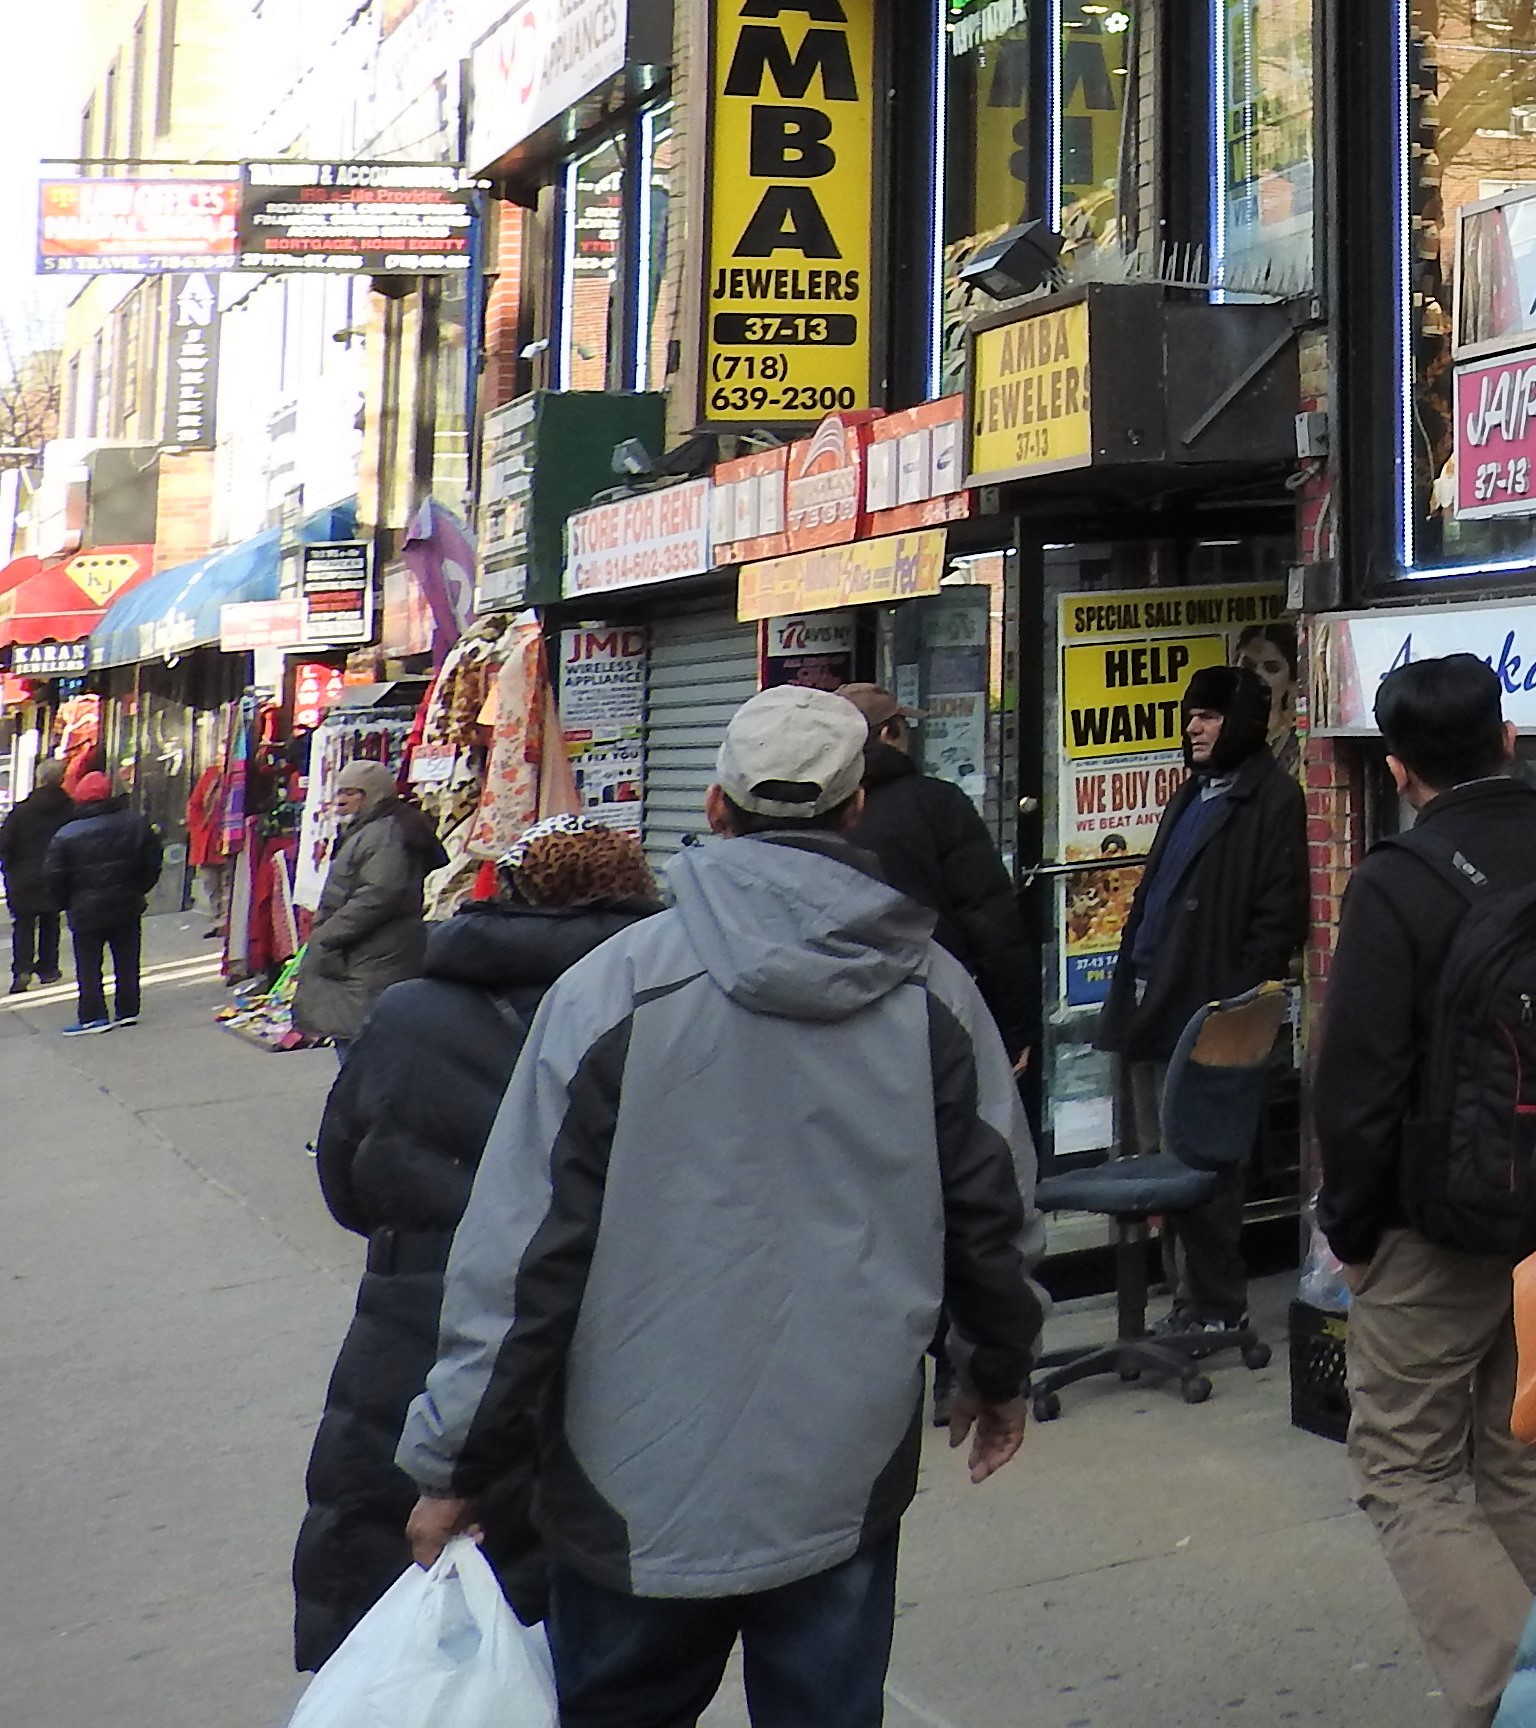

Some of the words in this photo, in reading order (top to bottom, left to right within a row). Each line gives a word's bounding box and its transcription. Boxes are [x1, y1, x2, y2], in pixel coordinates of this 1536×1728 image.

[713, 268, 859, 302] JEWELERS
[743, 317, 828, 343] 37-13
[1000, 313, 1070, 378] AMBA
[712, 352, 789, 382] (718)
[711, 386, 856, 412] 639-2300
[1015, 428, 1049, 461] 37-13
[1474, 455, 1531, 500] 37-13
[573, 505, 620, 557] STORE
[623, 496, 656, 545] FOR
[659, 483, 705, 537] RENT
[1073, 603, 1143, 633] SPECIAL
[1144, 600, 1182, 629] SALE
[1185, 597, 1225, 626] ONLY
[1226, 594, 1258, 623] FOR
[15, 644, 86, 663] KARAN
[566, 631, 645, 664] JMD
[1105, 644, 1190, 689] HELP
[1071, 698, 1188, 748] WANT
[1075, 773, 1107, 816] WE
[1111, 769, 1150, 812] BUY
[1075, 817, 1098, 833] WE
[1099, 814, 1132, 832] BEAT
